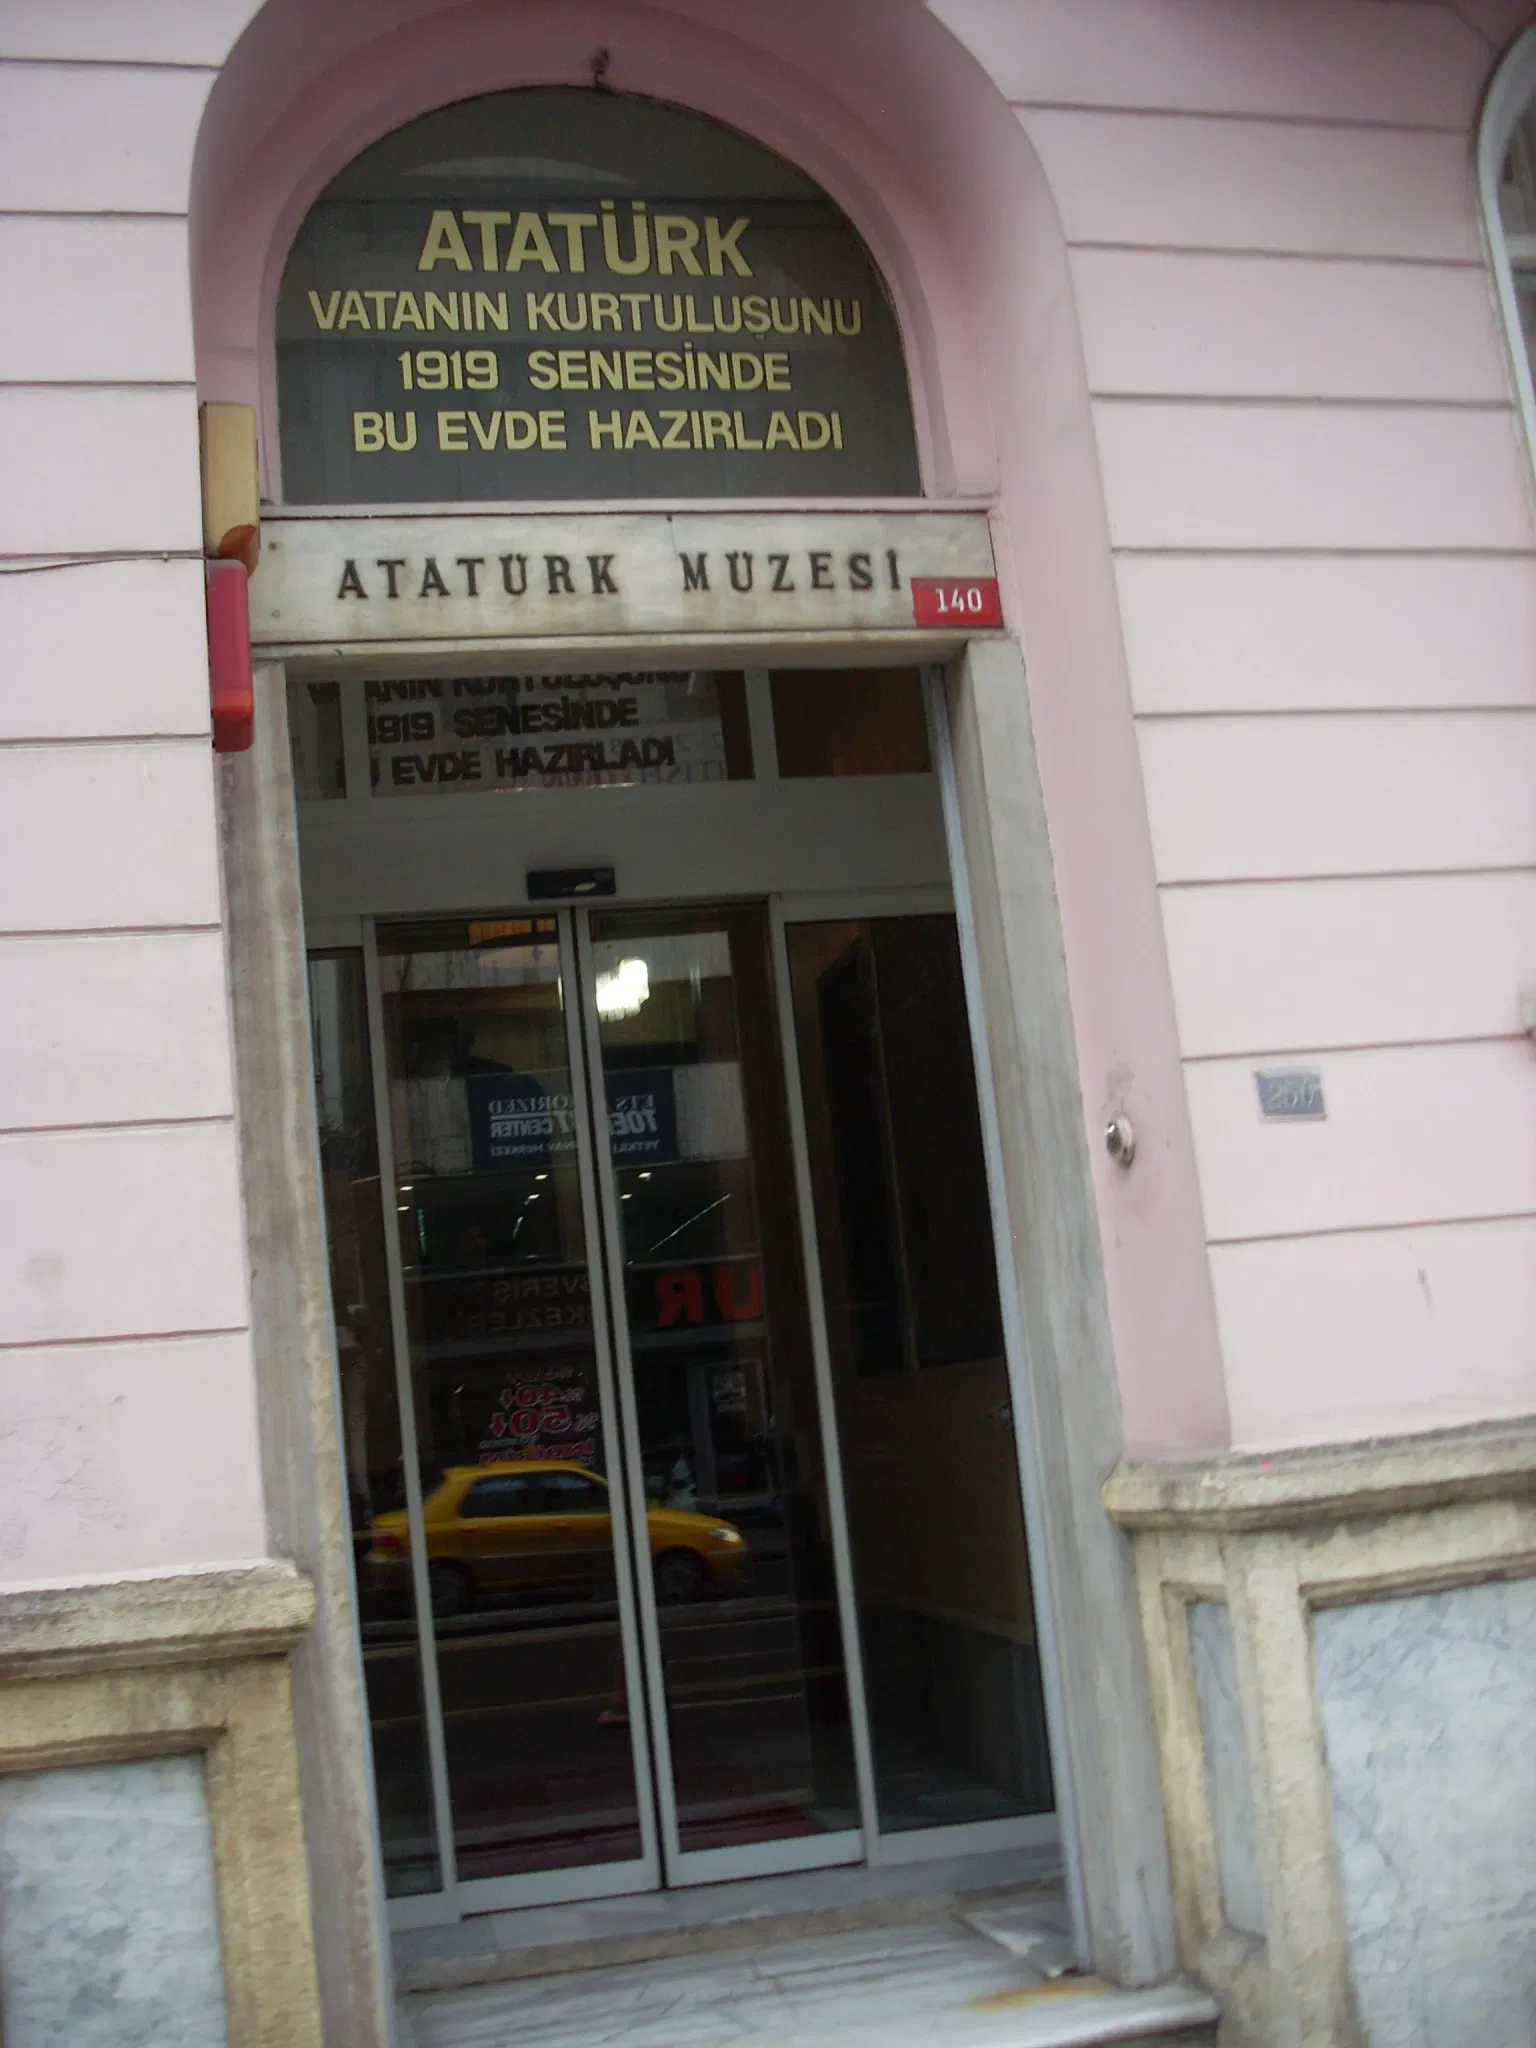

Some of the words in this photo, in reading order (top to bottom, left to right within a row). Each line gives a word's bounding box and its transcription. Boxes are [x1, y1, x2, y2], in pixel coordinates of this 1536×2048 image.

[417, 199, 758, 278] ATATÜRK
[307, 289, 510, 333] VATANIN
[526, 291, 864, 340] KURTULUŞUNU
[397, 349, 500, 392] 1919
[528, 341, 792, 392] SENESİNDE
[353, 411, 419, 453] BU
[437, 411, 568, 452] EVDE
[588, 410, 844, 452] HAZIRLADI
[336, 550, 620, 600] ATATÜRK
[678, 548, 902, 594] MÜZESİ
[935, 587, 982, 613] 140
[453, 695, 640, 738] SENESİNDE
[392, 749, 482, 787] EVDE
[495, 736, 675, 781] HAZIRLADI
